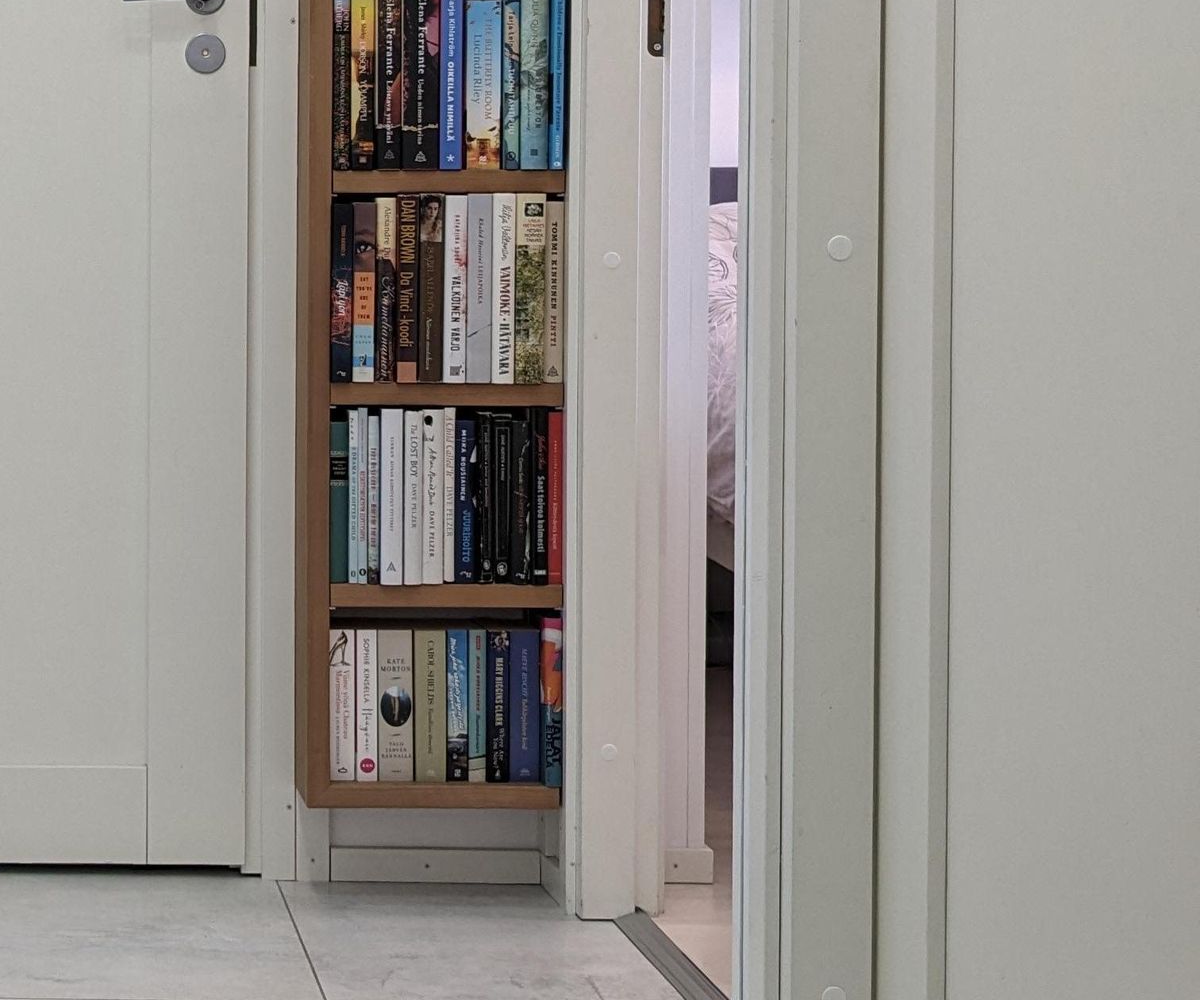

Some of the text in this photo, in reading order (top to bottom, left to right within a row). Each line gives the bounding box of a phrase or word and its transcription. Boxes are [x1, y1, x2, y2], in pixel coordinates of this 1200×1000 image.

[386, 28, 395, 75] Ferrante
[418, 27, 427, 74] Ferrante
[448, 19, 456, 57] Kihlström
[471, 34, 482, 104] Lucinda Riley
[446, 104, 455, 141] NIMILLÄ
[484, 90, 492, 119] ROOM
[380, 207, 395, 378] Alexandre Kamelianainen
[400, 200, 415, 347] DAN BROWN Da Vinci -koodi
[336, 280, 349, 316] Läpi yön
[451, 276, 461, 351] VALKOINEN VARJO
[499, 225, 512, 375] Valtonen VAIMOKE HÄTÄVARA
[410, 436, 418, 457] LOST
[446, 422, 454, 443] Child
[410, 460, 418, 477] BOY
[462, 510, 472, 563] JUURIHOITO
[537, 476, 545, 552] Saat toivoa kolmesti
[495, 658, 504, 725] MARY HIGGINS CLARK
[552, 718, 561, 765] JALAT
